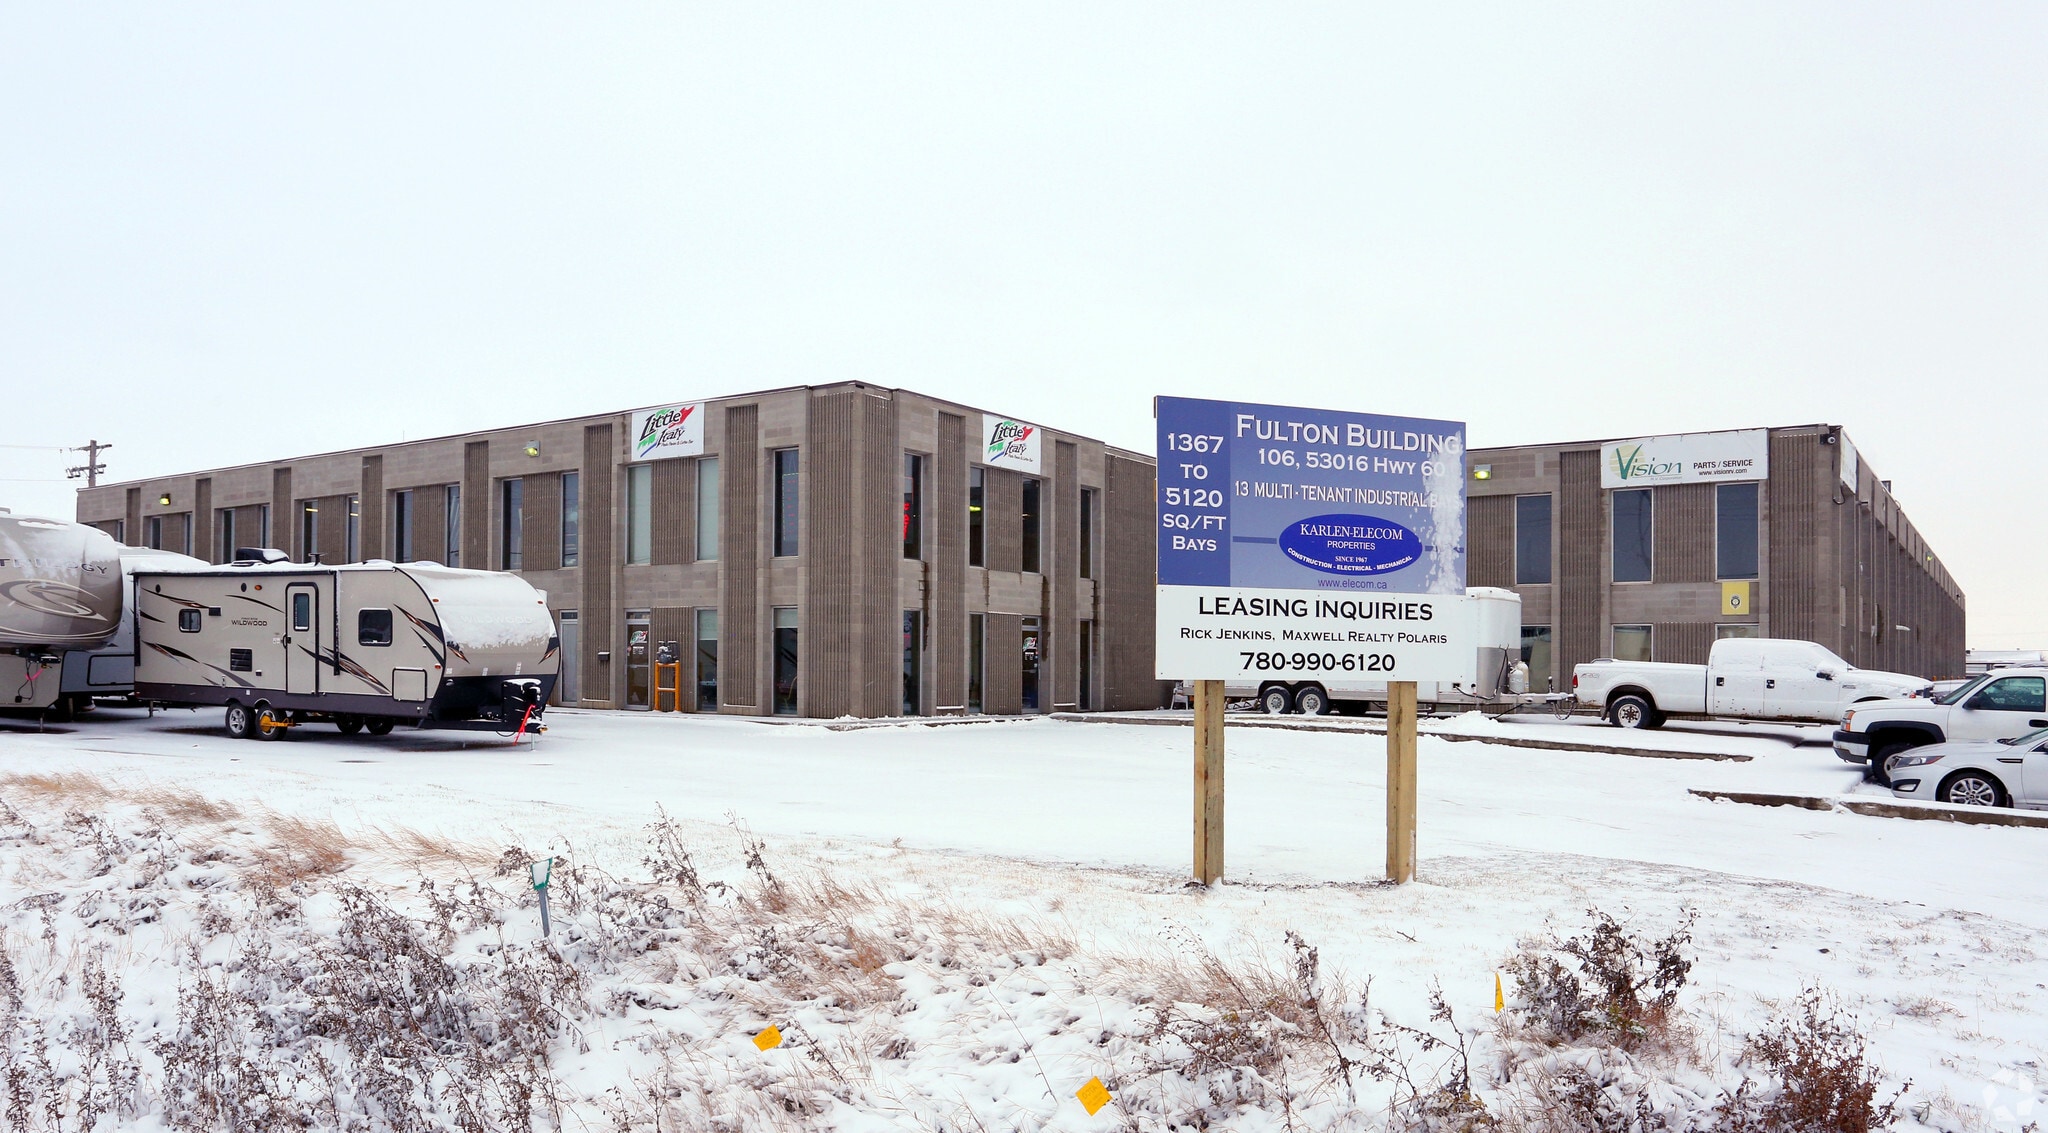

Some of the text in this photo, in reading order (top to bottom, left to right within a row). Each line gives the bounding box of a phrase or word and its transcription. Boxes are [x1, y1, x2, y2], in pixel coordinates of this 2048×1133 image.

[639, 410, 681, 441] Little
[989, 422, 1024, 446] Little
[1236, 413, 1460, 455] FULTON BUILDING
[656, 428, 685, 448] Italy
[1168, 432, 1224, 454] 1367
[1003, 441, 1027, 457] Italy
[1180, 463, 1208, 480] TO
[1258, 448, 1445, 477] 106, 53016 HWY 60
[1615, 443, 1682, 480] Vision
[1693, 461, 1716, 469] PARTS
[1722, 459, 1753, 468] SERVICE
[1698, 468, 1748, 476] www.visionrv.com
[1166, 487, 1223, 508] 5120
[1235, 480, 1249, 497] 13
[1254, 481, 1293, 499] MULTI
[1300, 484, 1352, 503] TENANT
[1354, 488, 1427, 508] INDUSTRIAL
[1162, 513, 1227, 531] SQ/FT
[1300, 523, 1403, 540] KARLEN-ELECOM
[1172, 535, 1217, 552] BAYS
[1327, 540, 1376, 550] PROPERTIES
[1287, 547, 1332, 569] CONSTRUCTION
[1376, 555, 1413, 570] MECHANICAL
[1318, 578, 1388, 590] www.elecom.ca
[1199, 596, 1433, 621] LEASING INQUIRIES
[231, 619, 268, 627] WILDWOOD
[1180, 627, 1448, 644] RICK JENKINS, MAXWELL REALTY POLARIS
[1240, 651, 1396, 672] 780-990-6120
